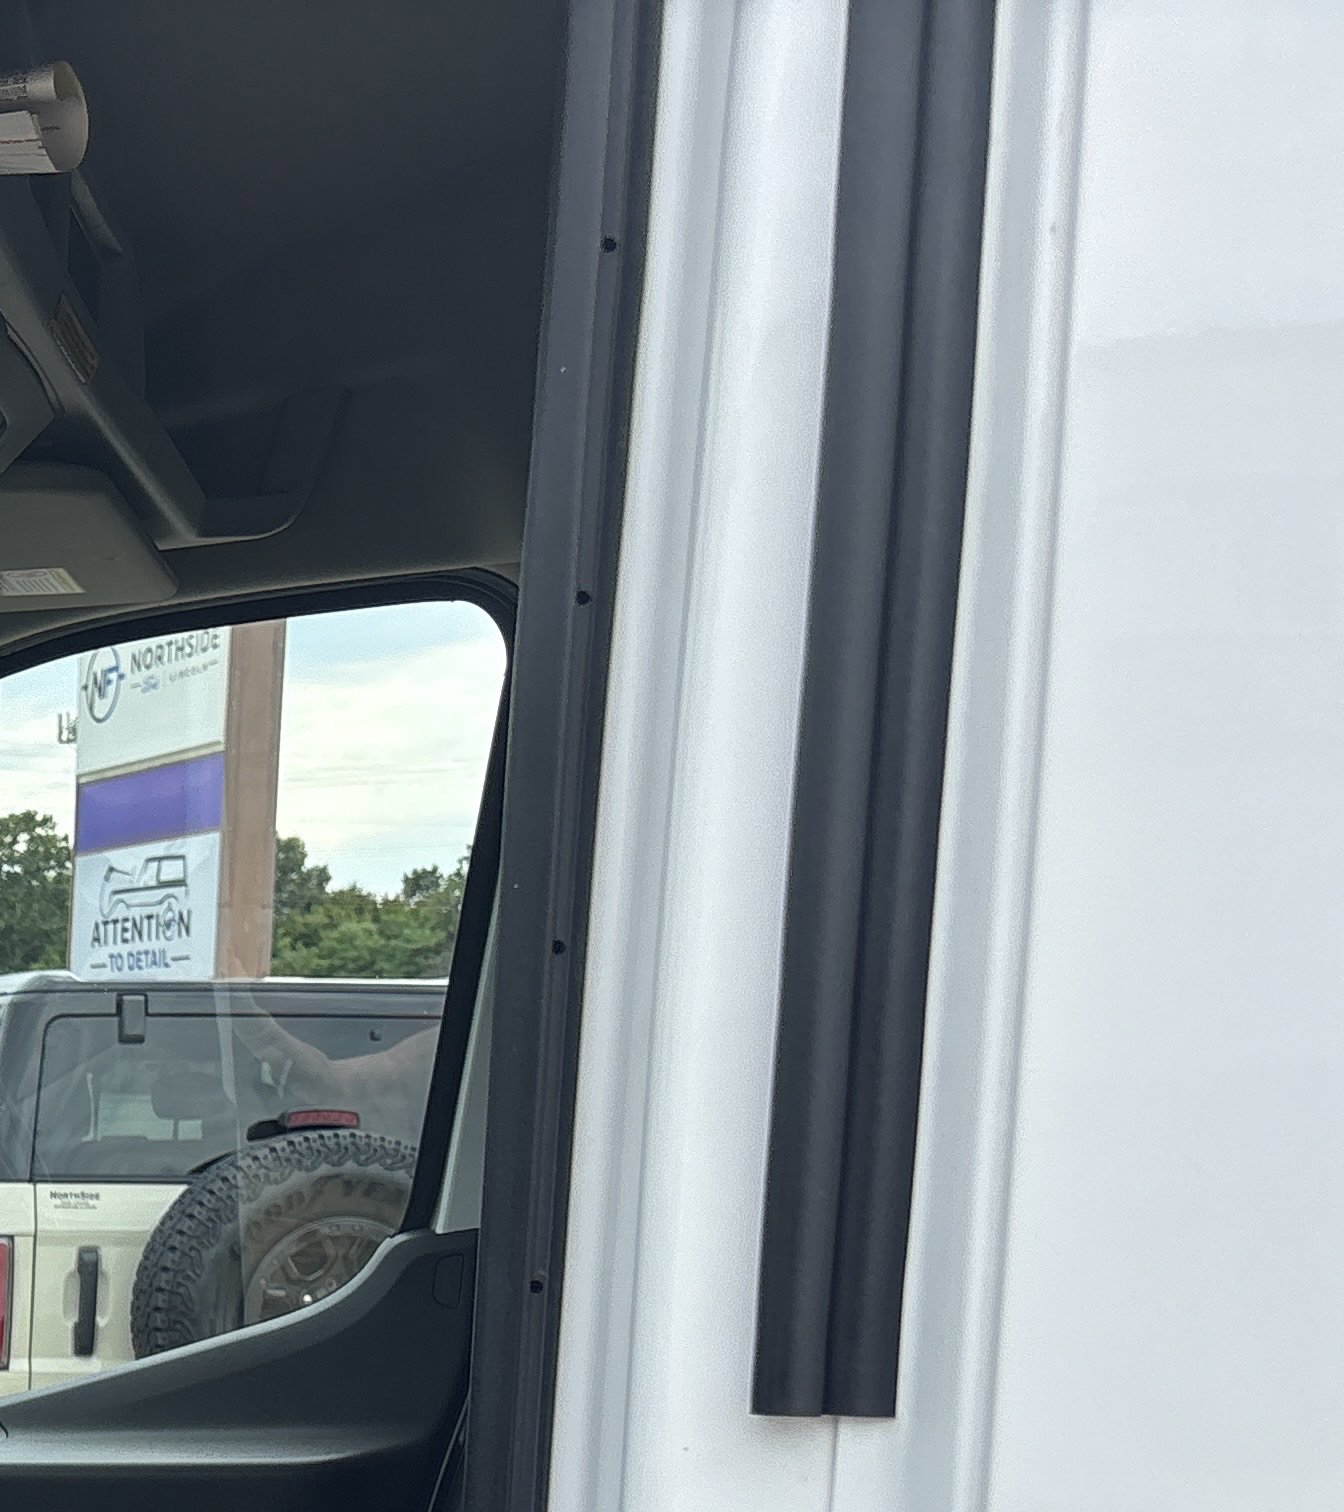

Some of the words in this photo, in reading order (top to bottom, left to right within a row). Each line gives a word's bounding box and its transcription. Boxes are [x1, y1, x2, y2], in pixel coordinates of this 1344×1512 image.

[131, 630, 221, 674] NORTHSIDE
[90, 903, 193, 949] ATTENTION
[108, 952, 124, 973] TO
[126, 948, 171, 972] DETAIL
